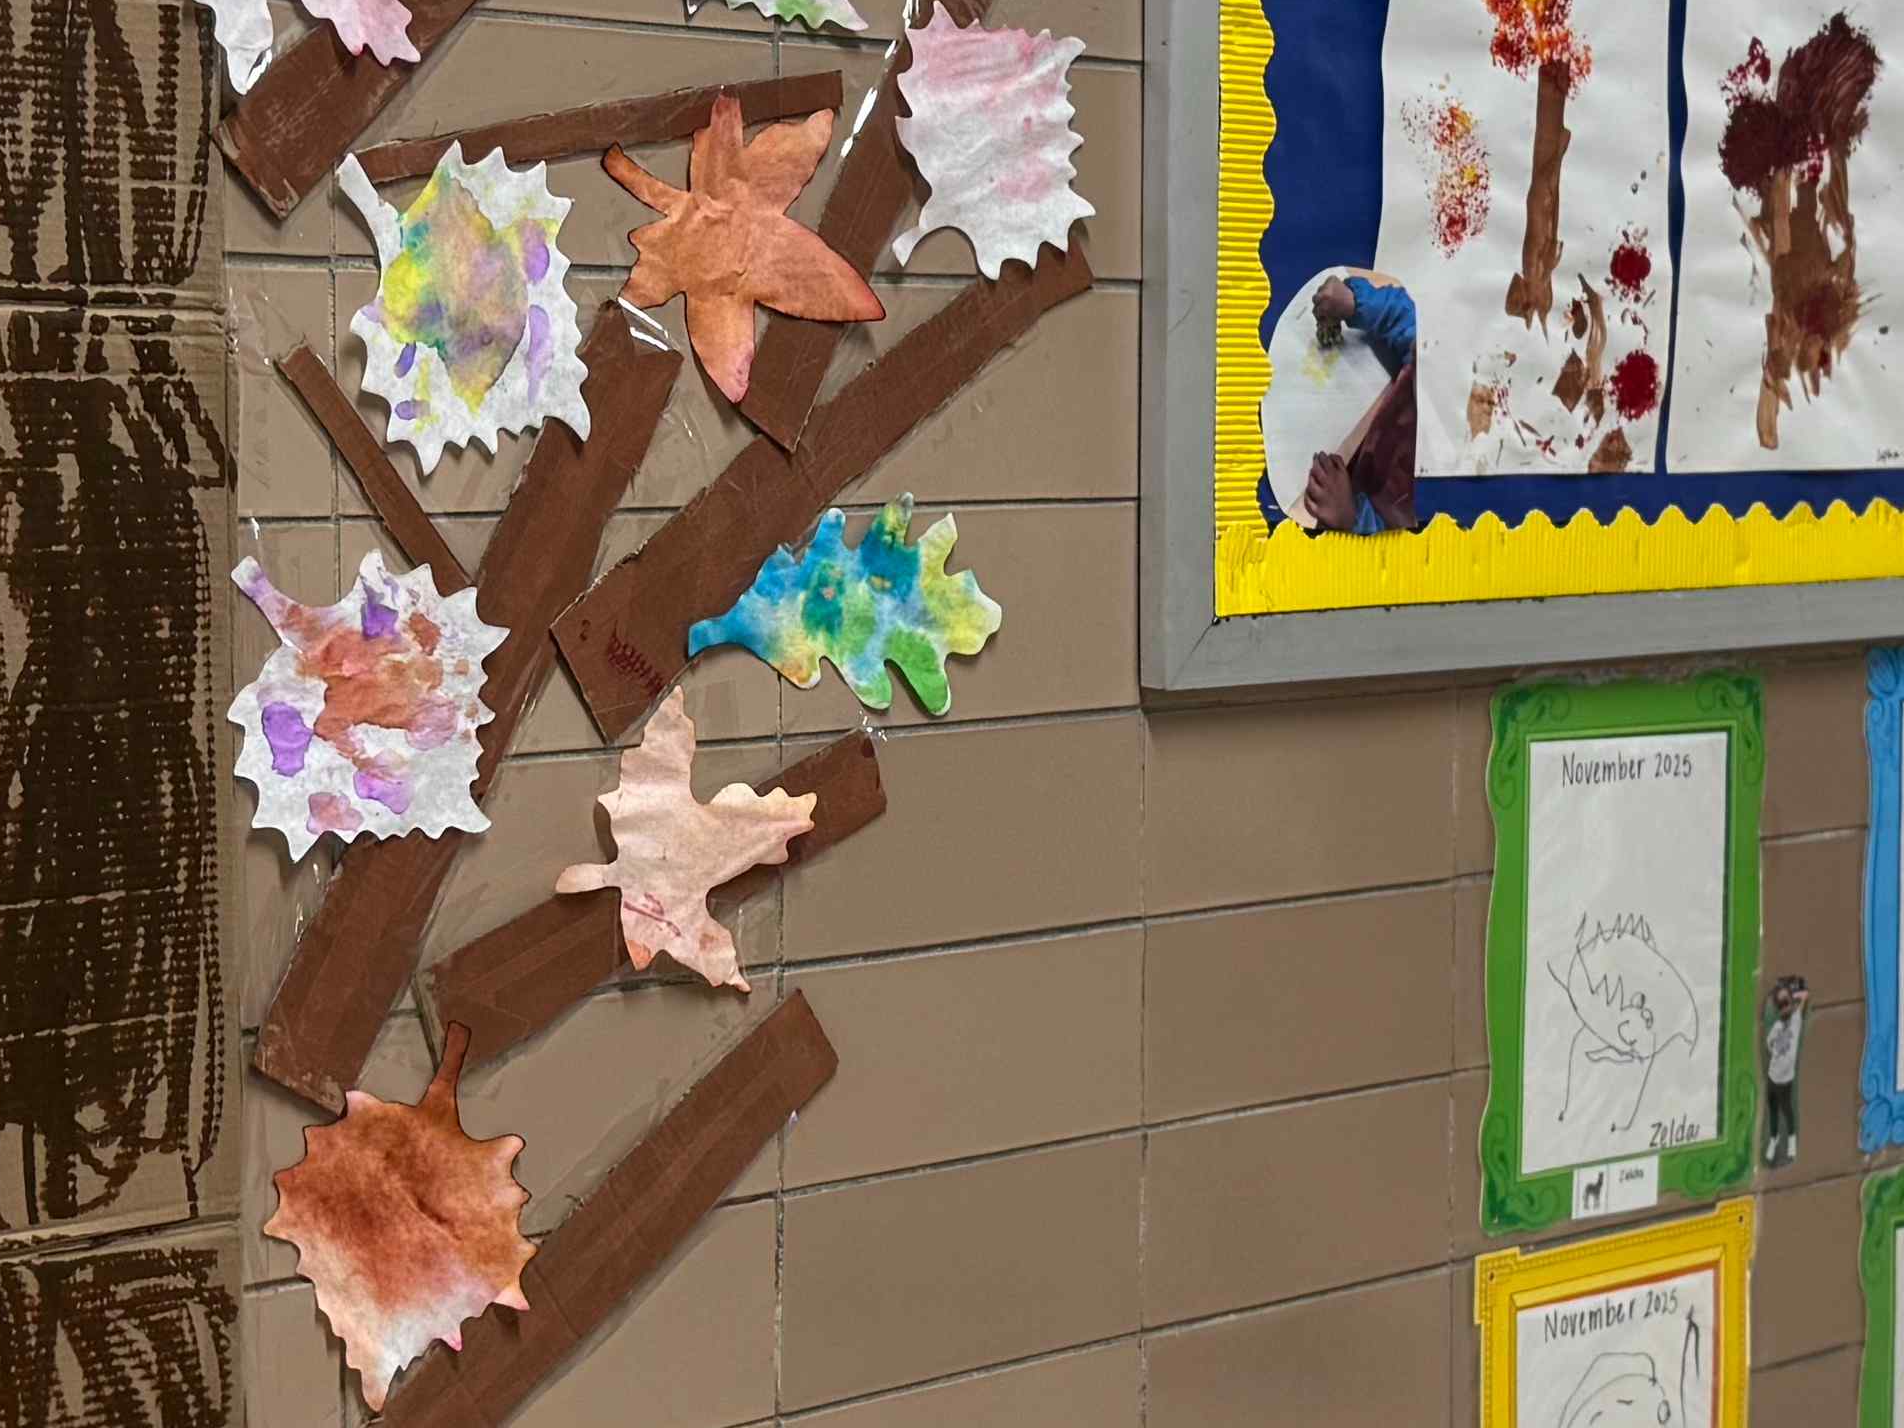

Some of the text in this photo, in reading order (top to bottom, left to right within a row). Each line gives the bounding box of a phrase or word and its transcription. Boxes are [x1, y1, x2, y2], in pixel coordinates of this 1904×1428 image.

[1562, 751, 1692, 788] November 2025
[1649, 1113, 1700, 1149] Zelda
[1544, 1286, 1678, 1343] November 2025
